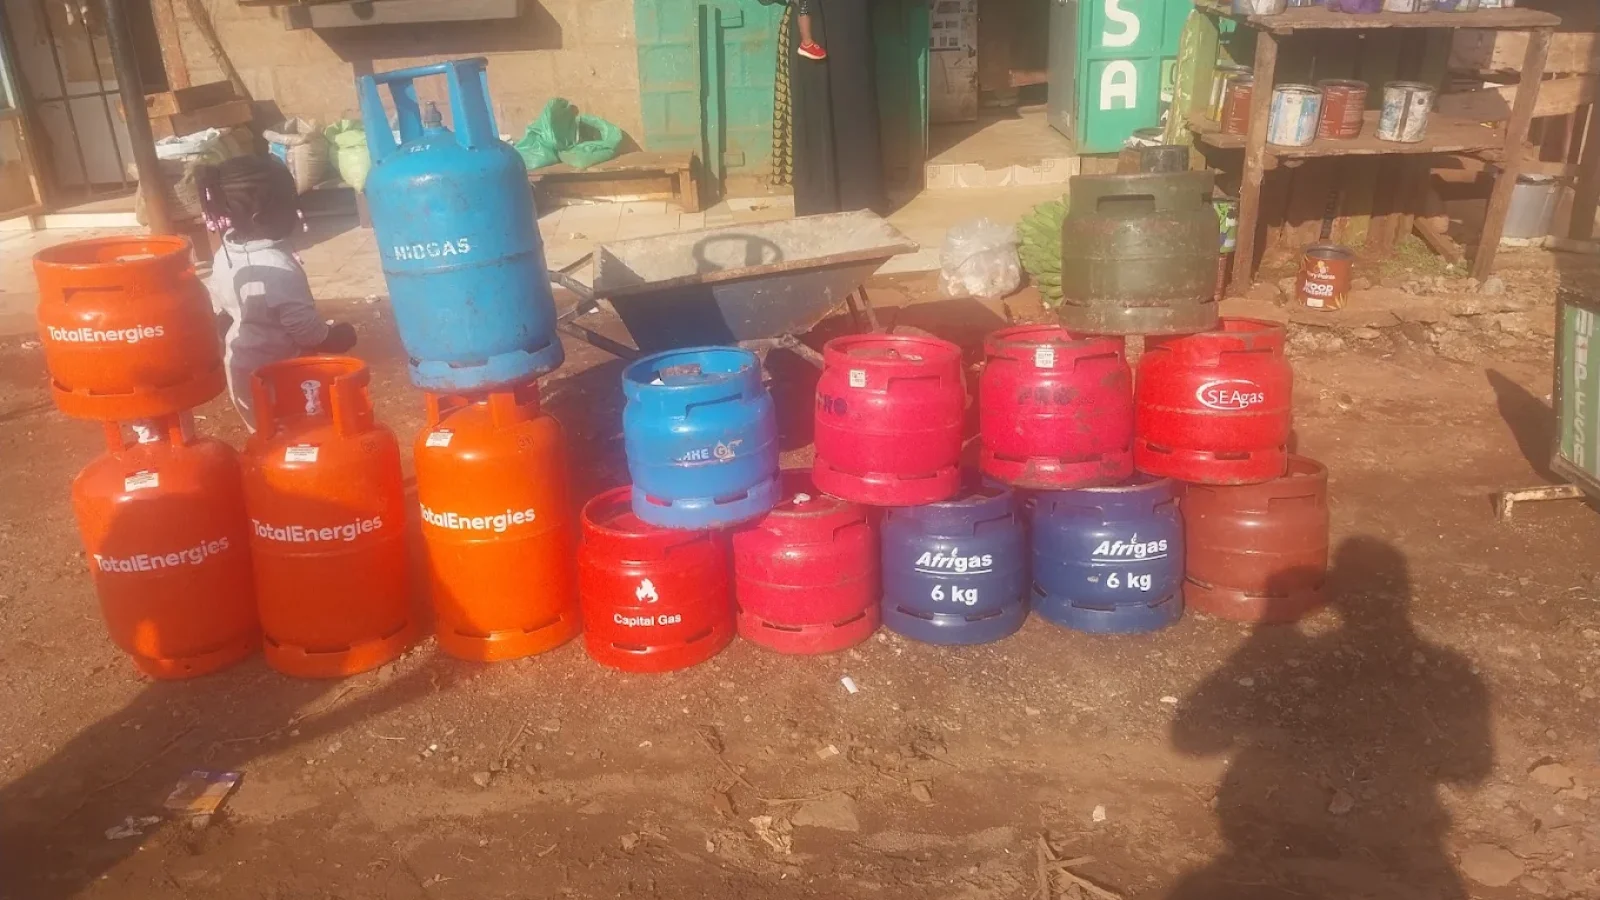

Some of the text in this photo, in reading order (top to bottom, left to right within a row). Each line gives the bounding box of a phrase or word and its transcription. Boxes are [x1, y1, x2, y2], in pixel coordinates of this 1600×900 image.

[48, 324, 165, 345] TotalEnergies
[674, 448, 710, 461] AKE
[251, 515, 383, 543] TotalEnergies
[93, 537, 230, 573] TotalEnergies
[1093, 533, 1168, 558] Afrigas
[915, 547, 993, 571] Afrigas
[1106, 571, 1152, 592] 6 kg
[931, 584, 978, 606] 6 kg
[613, 613, 681, 628] Capital Gas
